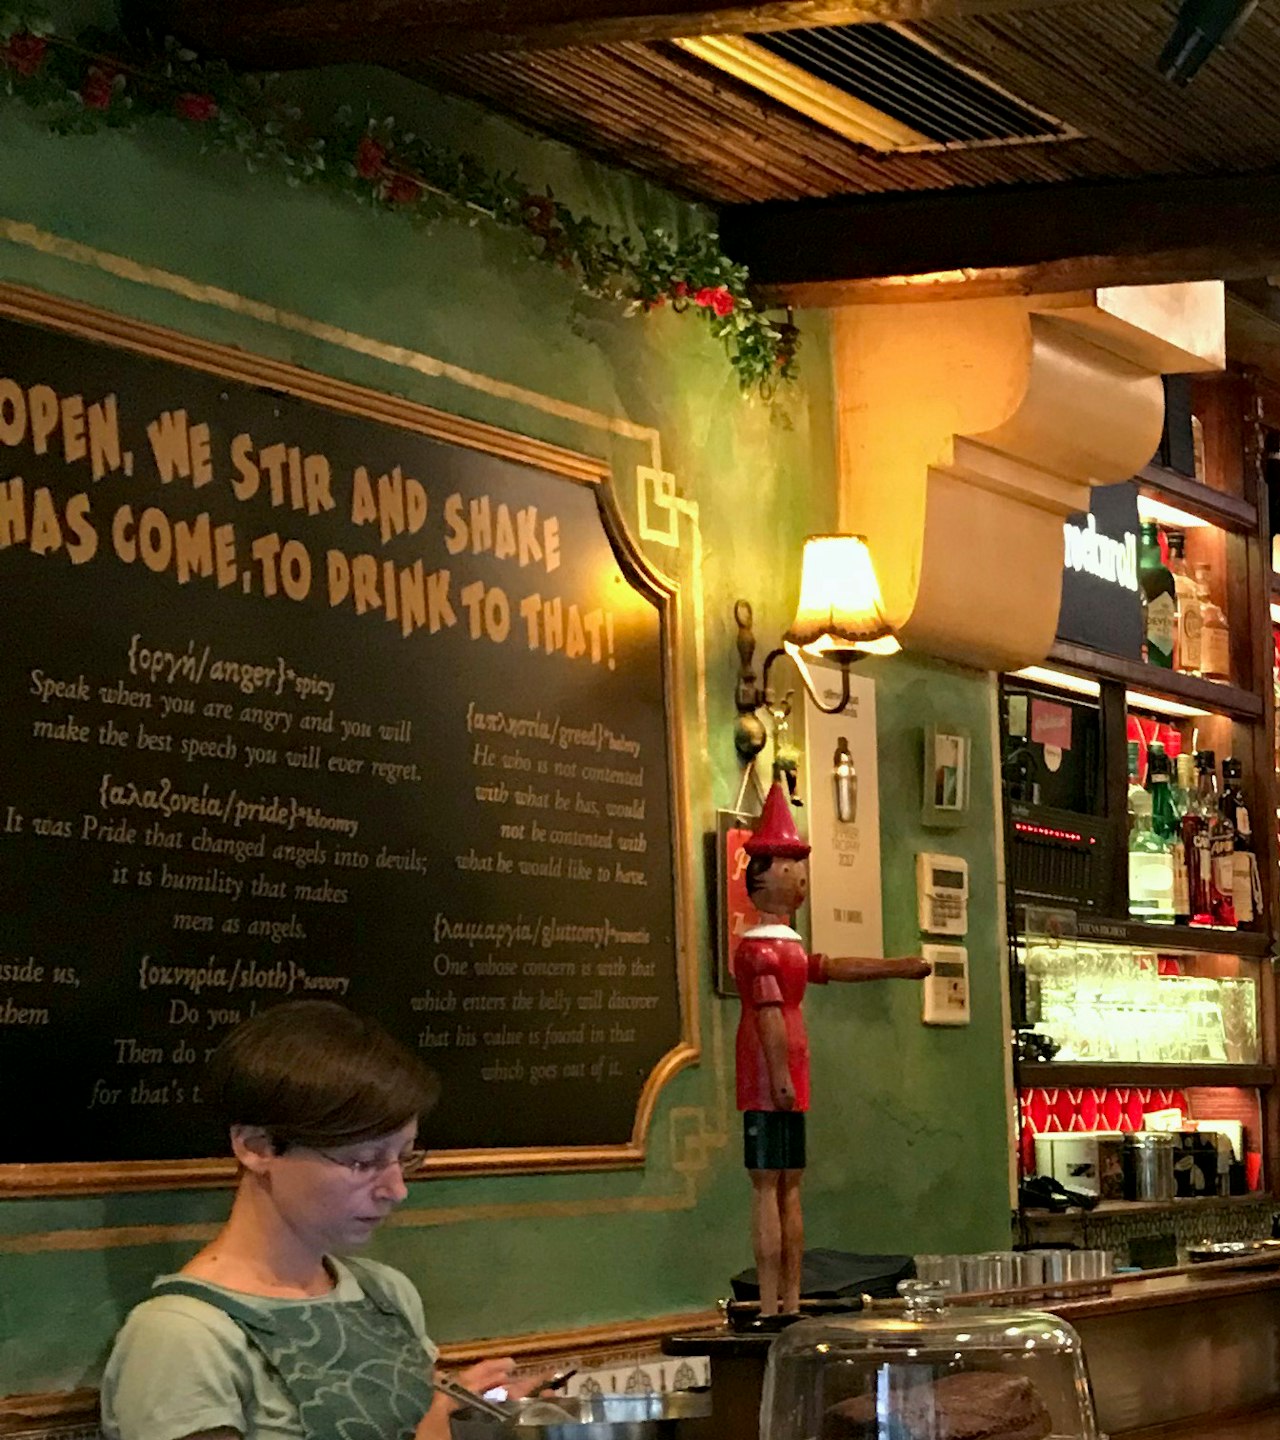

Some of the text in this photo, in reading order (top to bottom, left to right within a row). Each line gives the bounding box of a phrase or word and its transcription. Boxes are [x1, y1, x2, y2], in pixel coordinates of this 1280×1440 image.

[147, 408, 213, 489] WE
[230, 433, 336, 516] STIR
[352, 464, 428, 545] AND
[444, 492, 560, 573] SHAKE
[0, 476, 98, 565] HAS
[252, 533, 311, 598] TO
[327, 549, 457, 639] DRINK
[461, 580, 510, 643] TO
[521, 593, 615, 671] THAT!
[30, 669, 412, 742] Speak when you are angry and you will
[33, 715, 422, 784] make the best speech you will ever regret.
[472, 743, 496, 767] He
[502, 750, 531, 772] who
[538, 760, 548, 774] is
[554, 762, 577, 778] not
[475, 782, 509, 804] with
[514, 786, 549, 809] what
[4, 806, 23, 833] It
[32, 818, 72, 838] was
[80, 814, 137, 845] Pride
[145, 821, 182, 849] that
[191, 827, 265, 862] changed
[272, 840, 326, 869] angels
[335, 845, 369, 869] into
[501, 823, 525, 840] not
[455, 849, 493, 872] what
[518, 856, 562, 878] would
[597, 868, 611, 883] to
[112, 860, 348, 904] it is humility that makes
[172, 914, 307, 944] men as angels.
[52, 966, 80, 989] us,
[434, 954, 467, 976] One
[169, 999, 199, 1024] Do
[207, 1009, 241, 1030] you
[511, 990, 533, 1011] the
[114, 1038, 163, 1064] Then
[173, 1040, 196, 1064] do
[87, 1079, 121, 1109] for
[131, 1079, 184, 1104] that's
